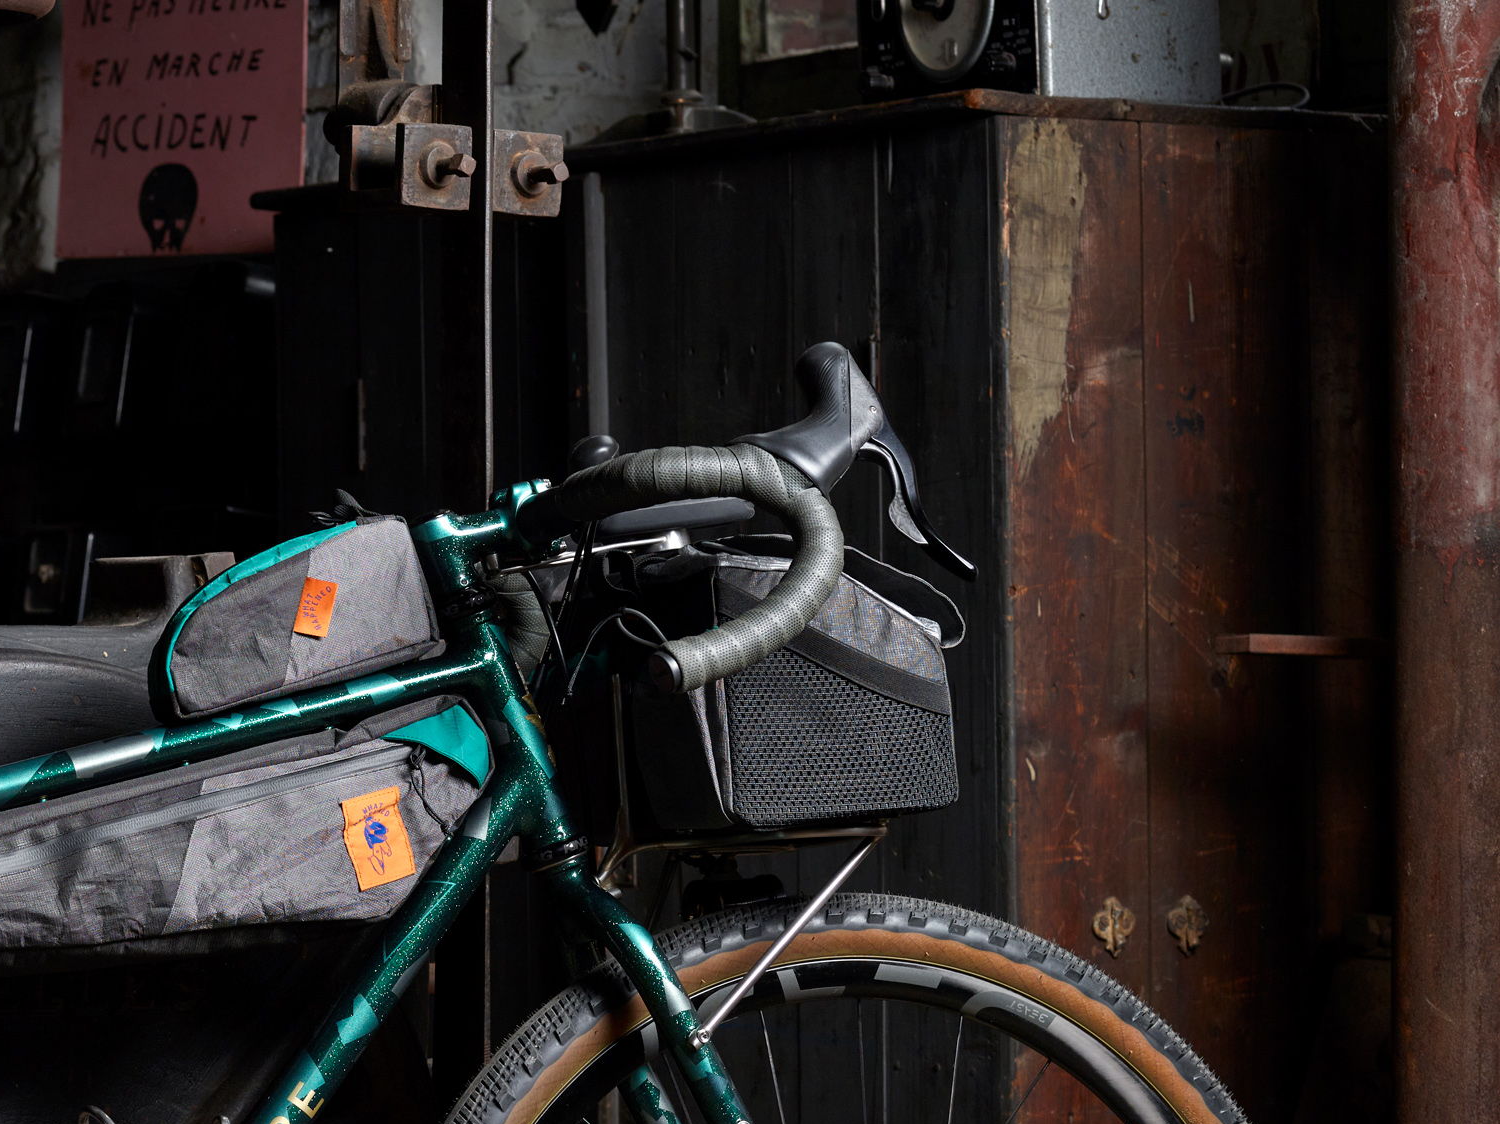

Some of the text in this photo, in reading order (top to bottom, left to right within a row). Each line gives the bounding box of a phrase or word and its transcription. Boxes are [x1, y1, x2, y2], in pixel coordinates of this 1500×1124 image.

[82, 0, 112, 27] NE
[91, 49, 264, 87] EN MARCHE
[91, 103, 257, 158] ACCIDENT
[302, 593, 313, 618] WHAT
[309, 585, 332, 631] HAPPENED
[362, 802, 384, 815] WHAT
[563, 834, 589, 855] KING
